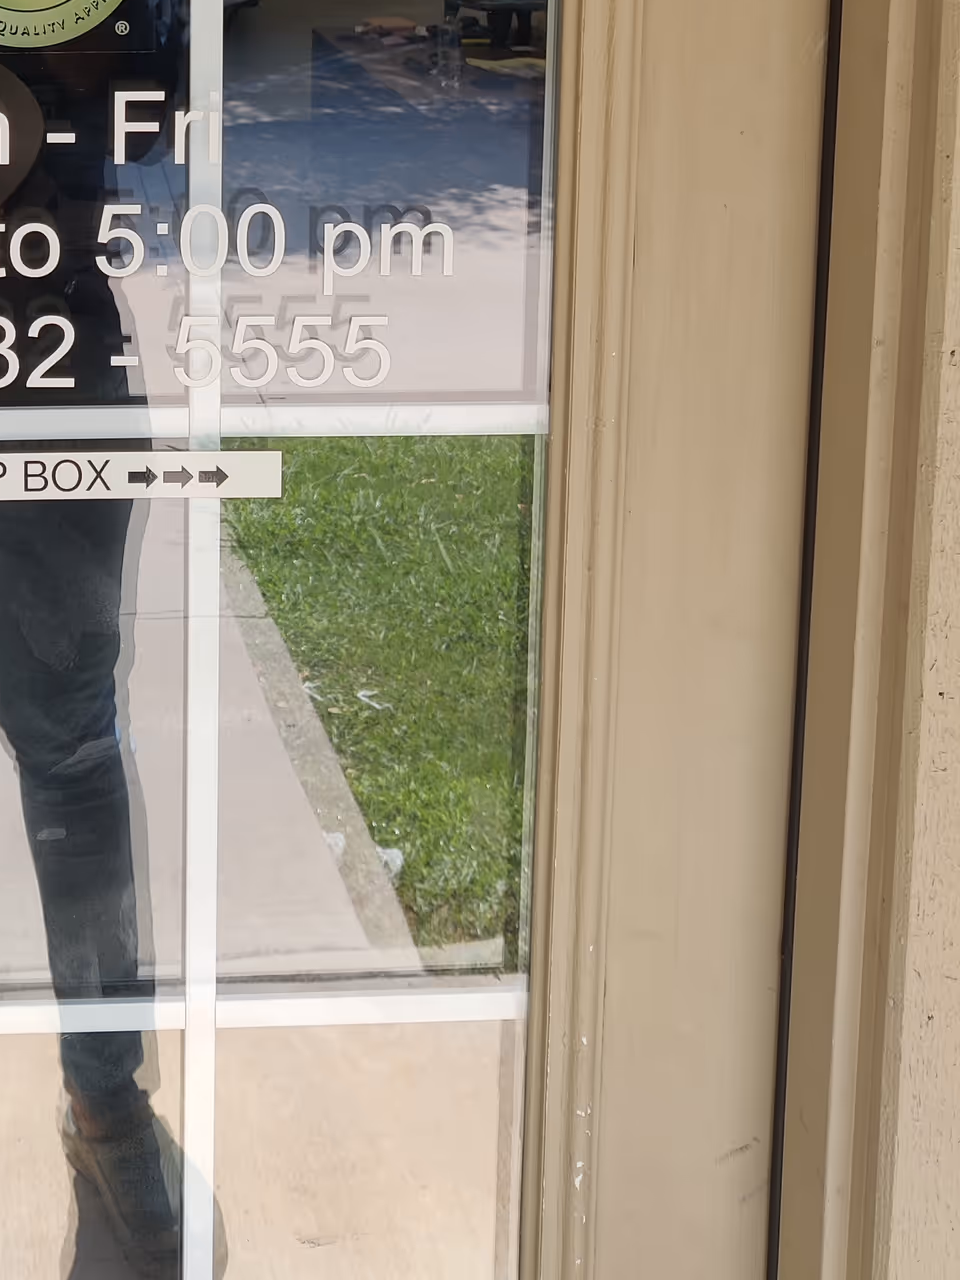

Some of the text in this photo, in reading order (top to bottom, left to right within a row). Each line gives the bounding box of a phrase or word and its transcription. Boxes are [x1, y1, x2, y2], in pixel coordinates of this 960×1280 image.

[113, 90, 220, 166] Fri
[95, 203, 286, 278] 5:00
[323, 221, 455, 296] pm
[173, 316, 392, 388] 5555
[23, 458, 113, 493] BOX
